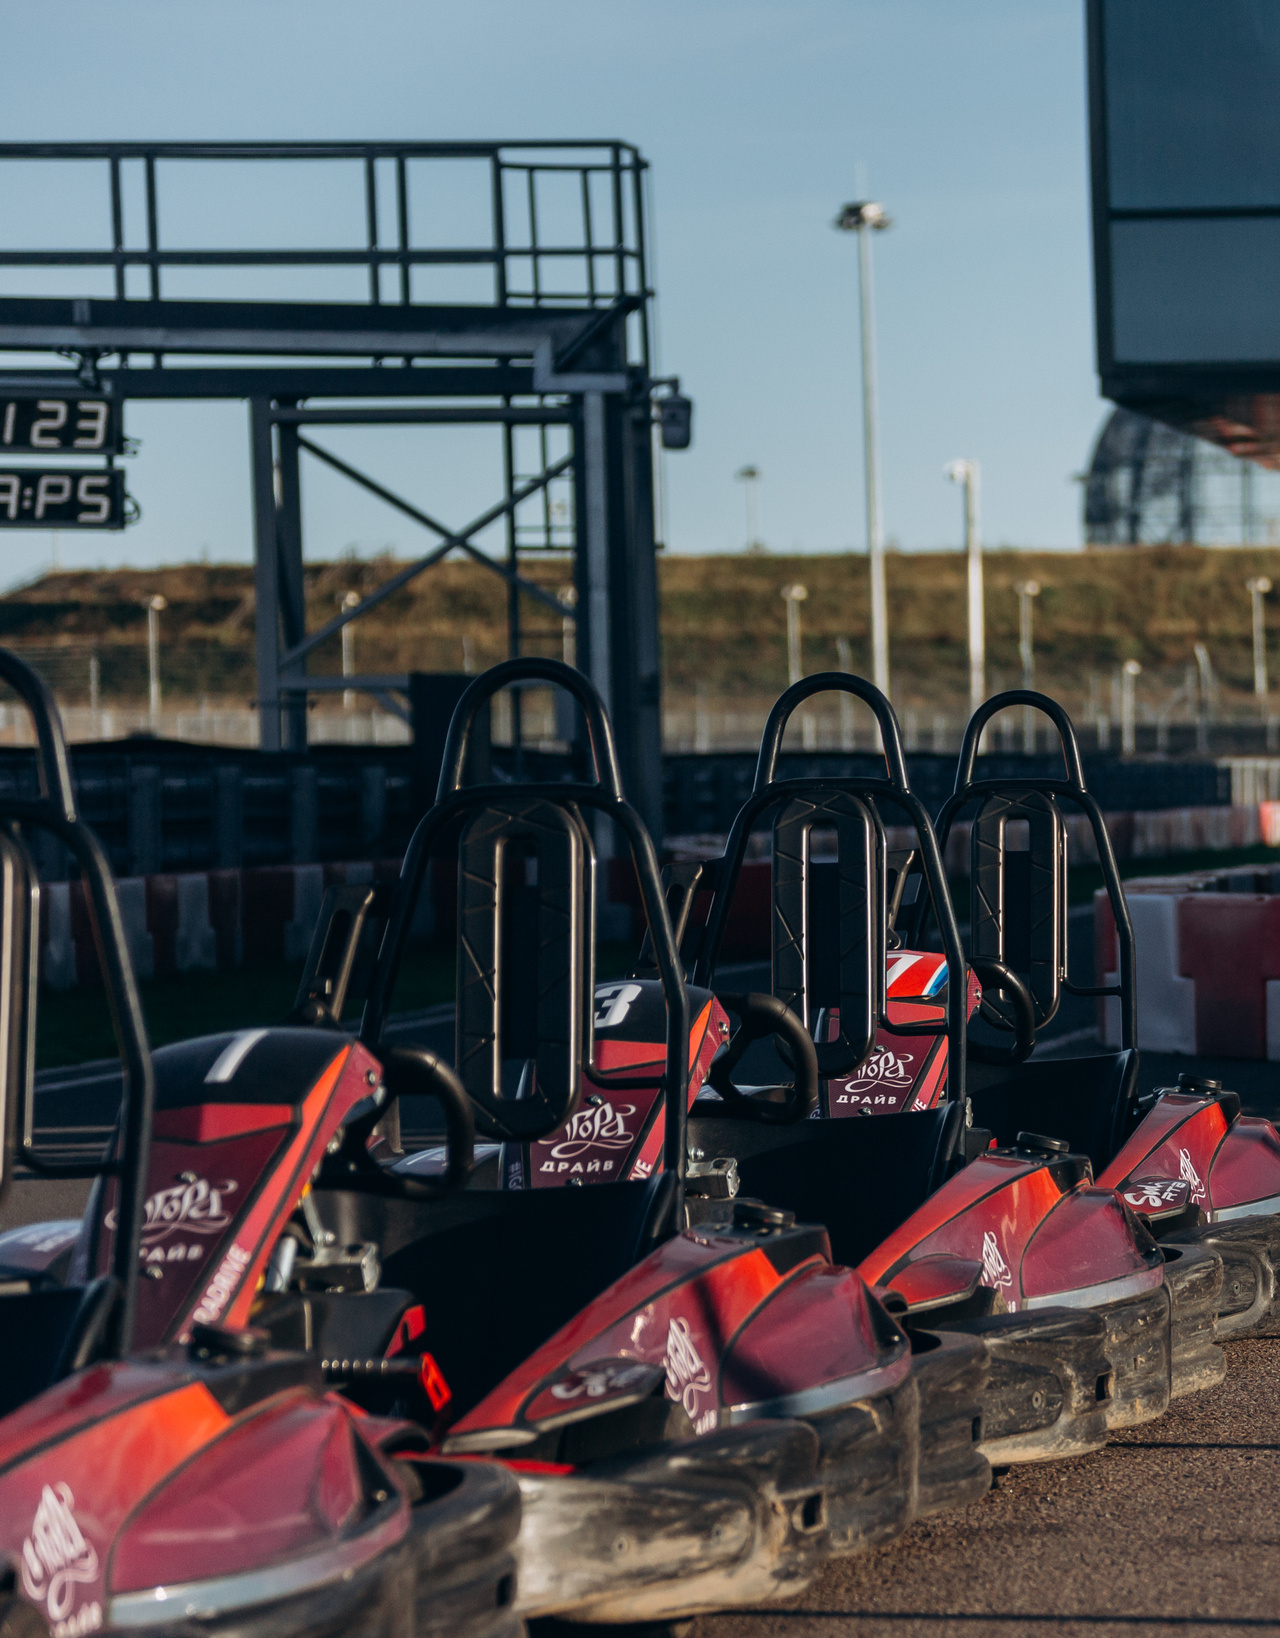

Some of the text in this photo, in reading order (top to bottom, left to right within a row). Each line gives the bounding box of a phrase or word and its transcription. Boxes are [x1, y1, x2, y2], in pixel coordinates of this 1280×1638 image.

[594, 984, 642, 1029] 3
[835, 1094, 897, 1105] ДРАЙВ
[539, 1158, 614, 1173] ДРАЙВ
